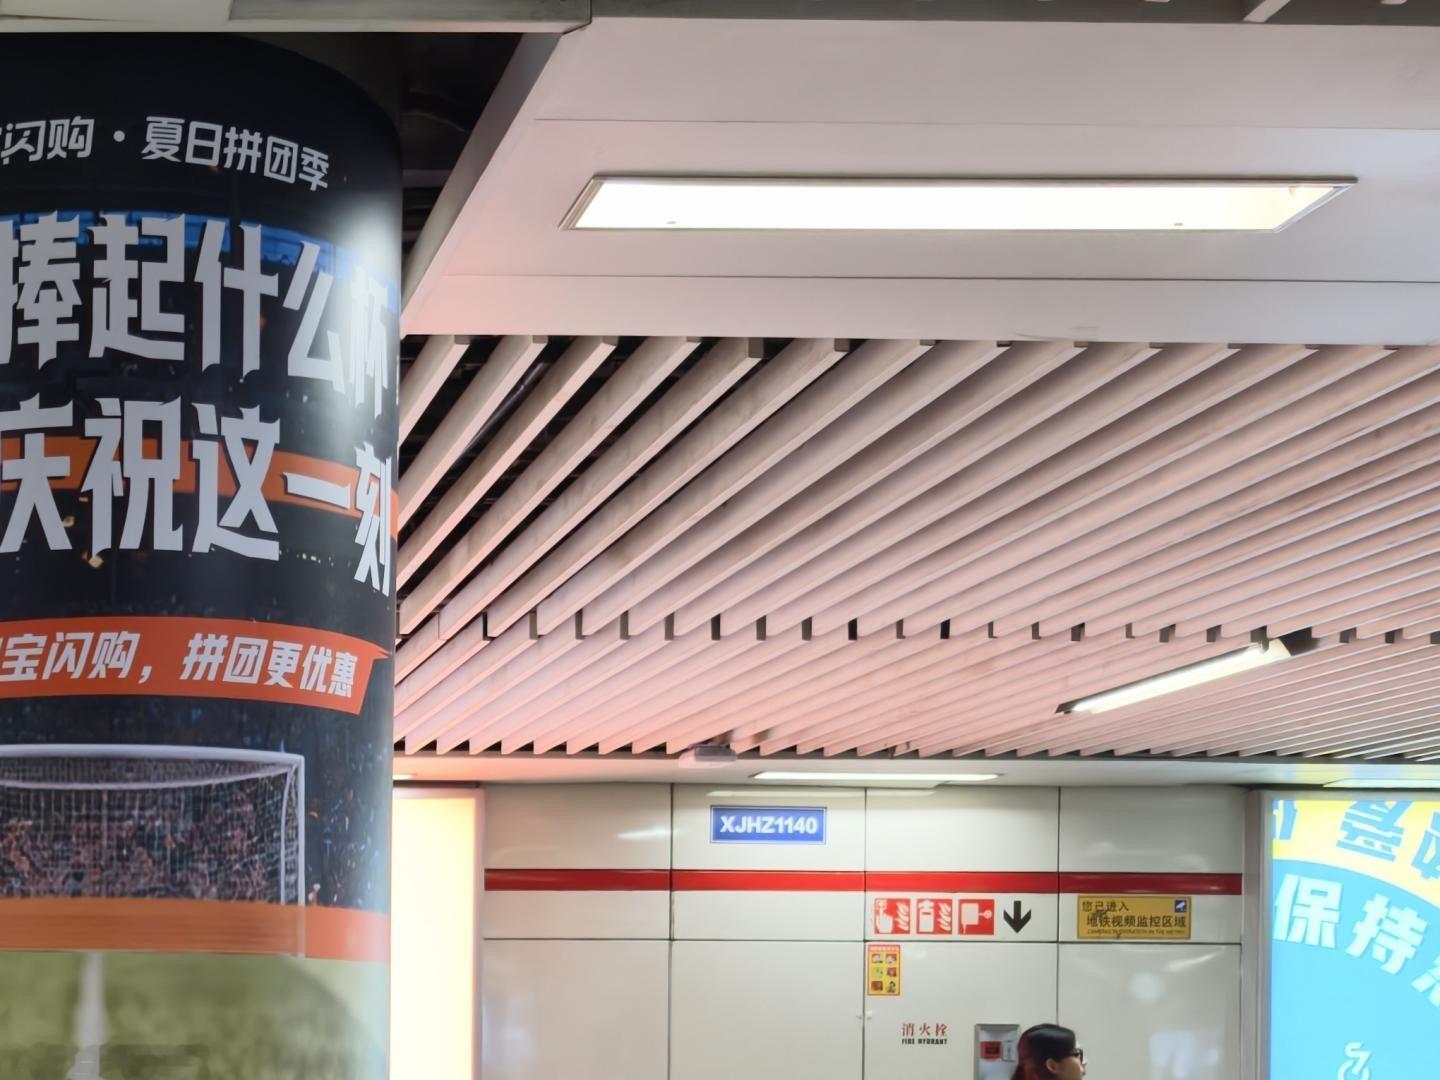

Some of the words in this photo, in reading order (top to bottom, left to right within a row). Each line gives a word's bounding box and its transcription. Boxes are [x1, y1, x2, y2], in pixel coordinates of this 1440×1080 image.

[720, 815, 818, 834] XJHZ1140
[902, 1023, 948, 1037] 消火栓
